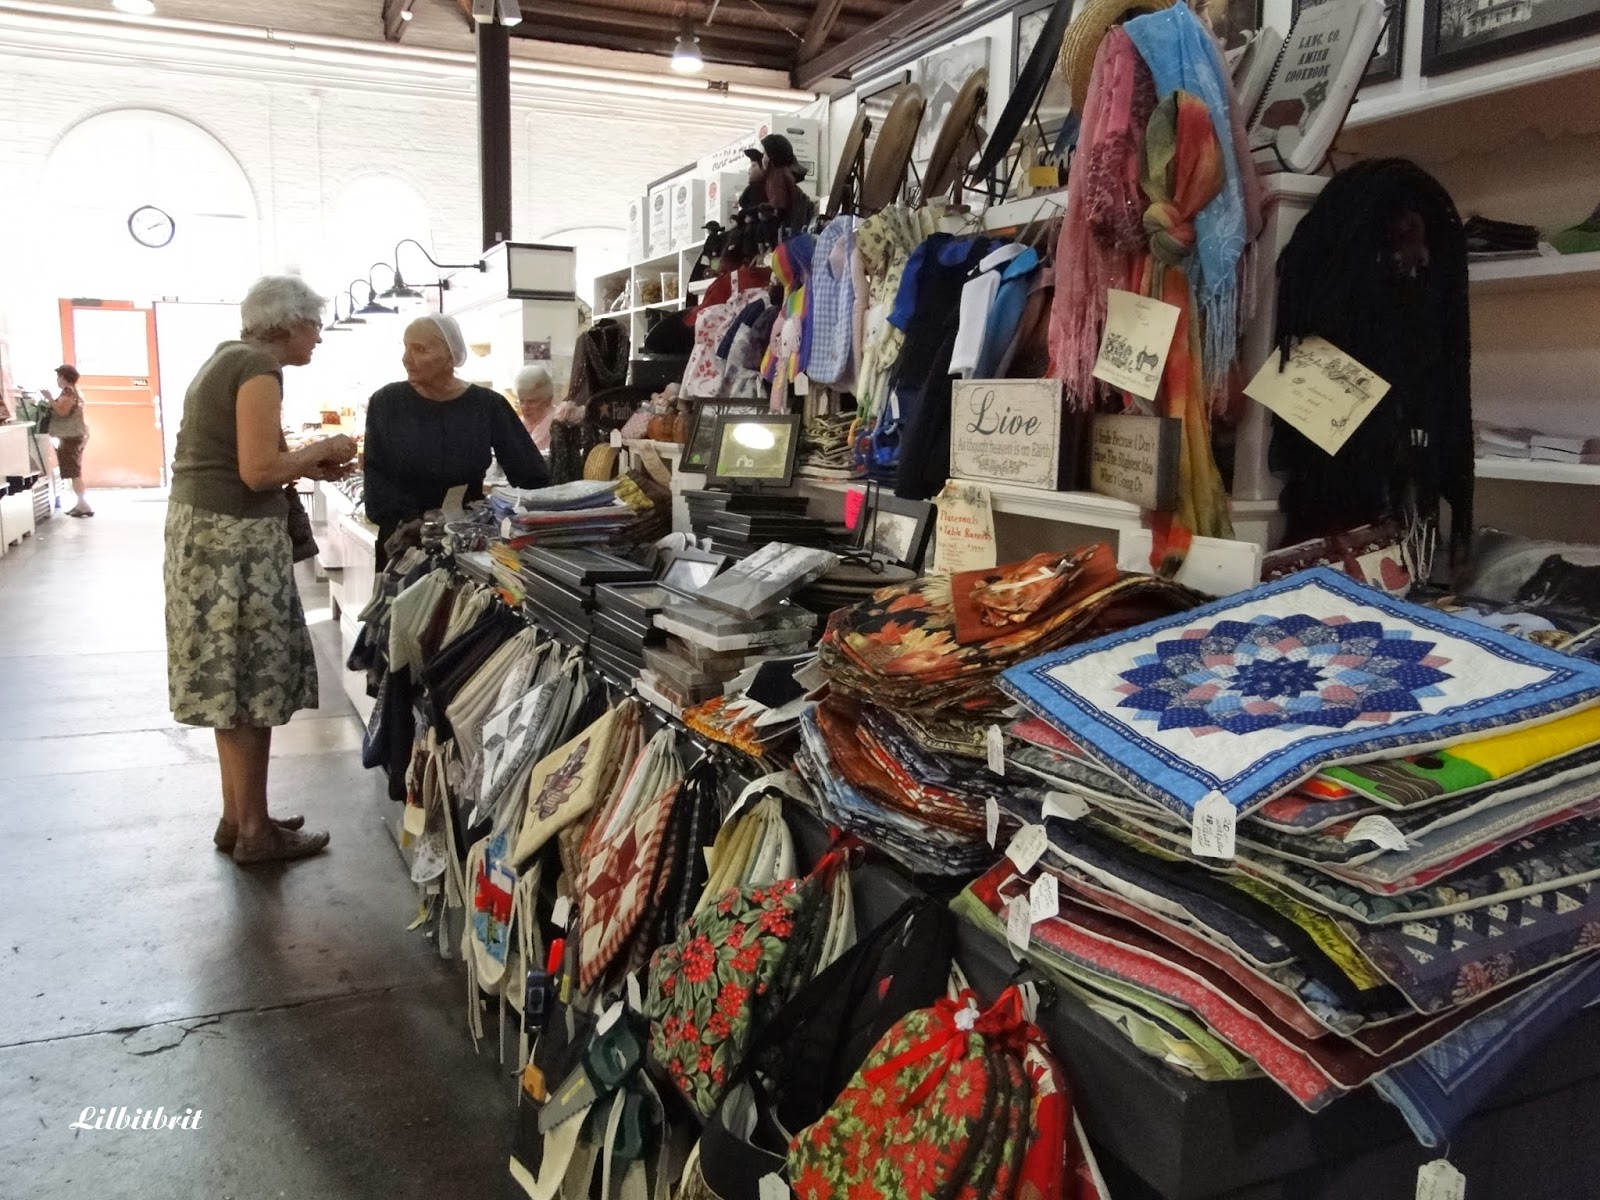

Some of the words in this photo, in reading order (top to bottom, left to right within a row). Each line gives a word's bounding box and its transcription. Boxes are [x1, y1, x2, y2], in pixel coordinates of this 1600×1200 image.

[1297, 48, 1330, 65] AMISH
[1285, 64, 1331, 82] COOKBOOK
[966, 387, 1042, 436] Live
[958, 438, 965, 451] As
[967, 438, 988, 455] though
[990, 440, 1012, 455] heaven
[1014, 441, 1020, 455] is
[1021, 445, 1030, 456] on
[1032, 442, 1051, 458] Earth
[1112, 430, 1133, 448] Because
